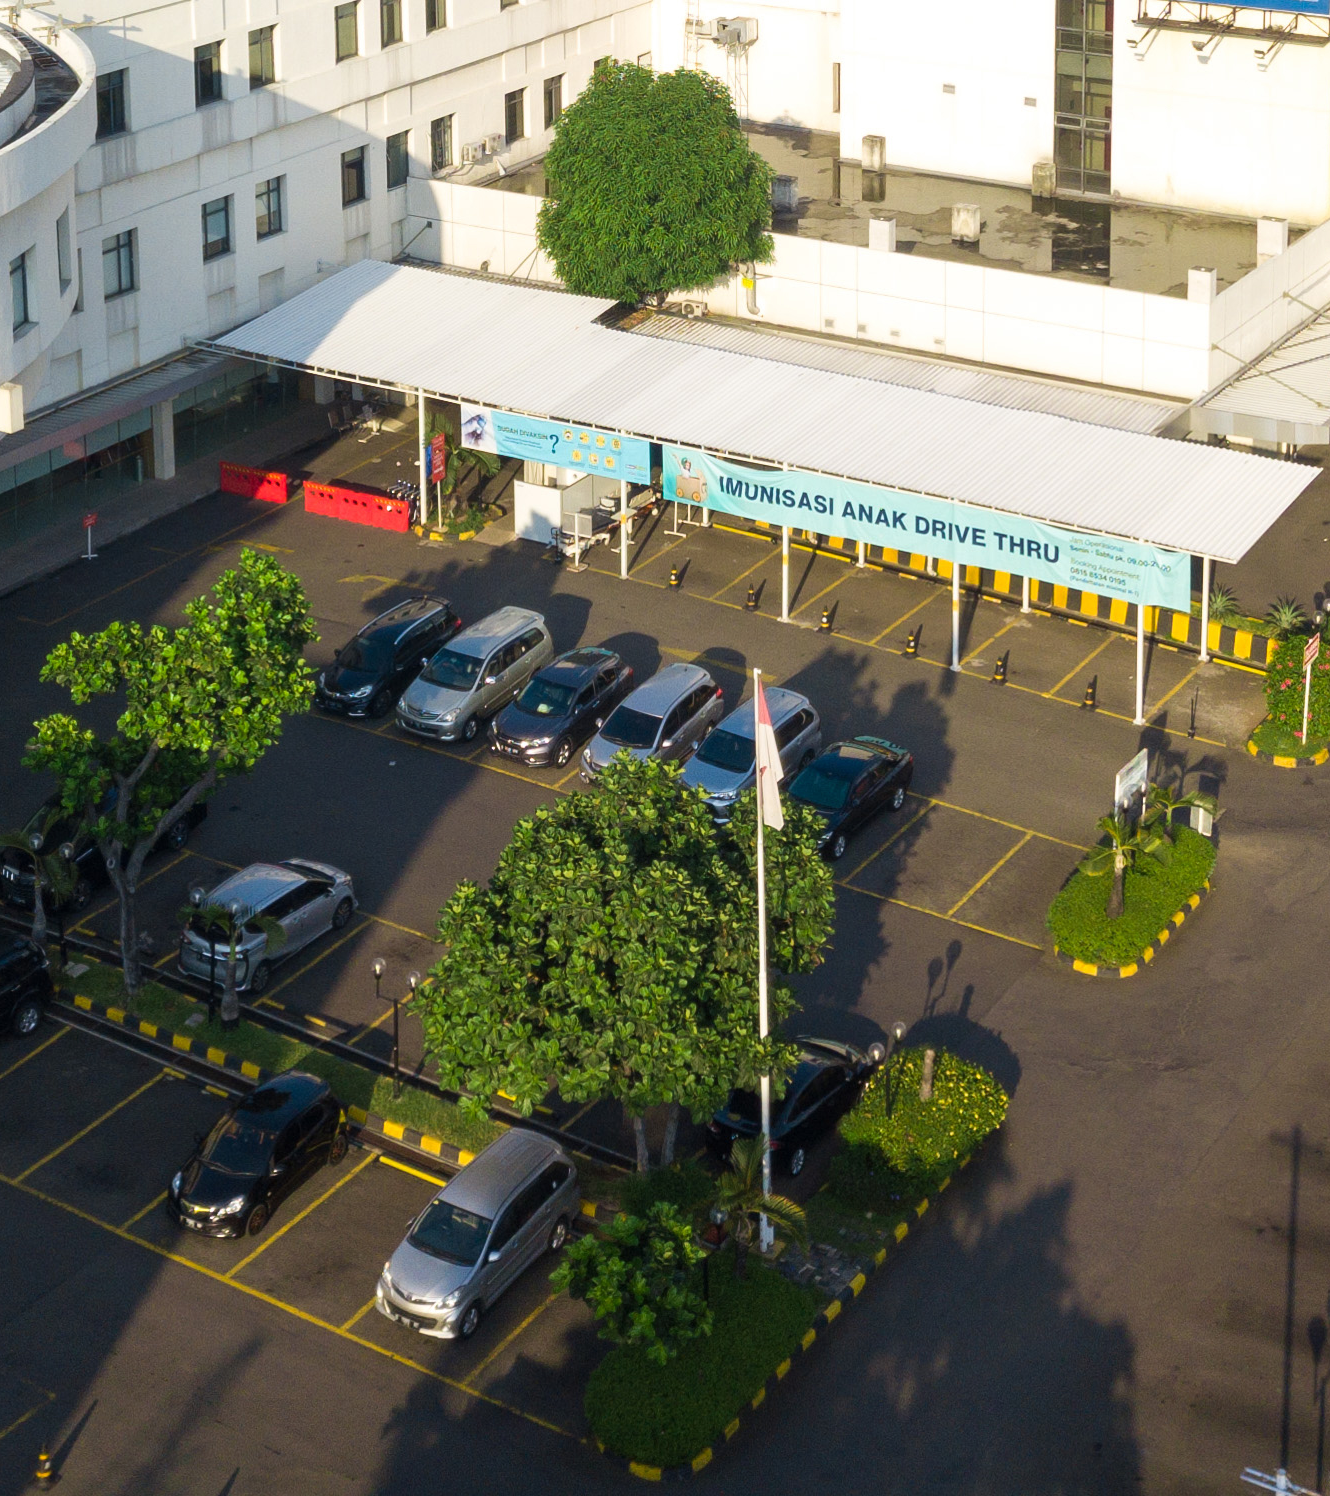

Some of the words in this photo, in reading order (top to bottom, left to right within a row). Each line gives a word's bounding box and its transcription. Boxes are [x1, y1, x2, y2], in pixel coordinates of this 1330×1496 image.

[549, 434, 560, 454] ?
[719, 475, 834, 516] IMUNISASI
[841, 501, 908, 531] ANAK
[915, 515, 987, 547] DRIVE
[993, 531, 1060, 564] THRU
